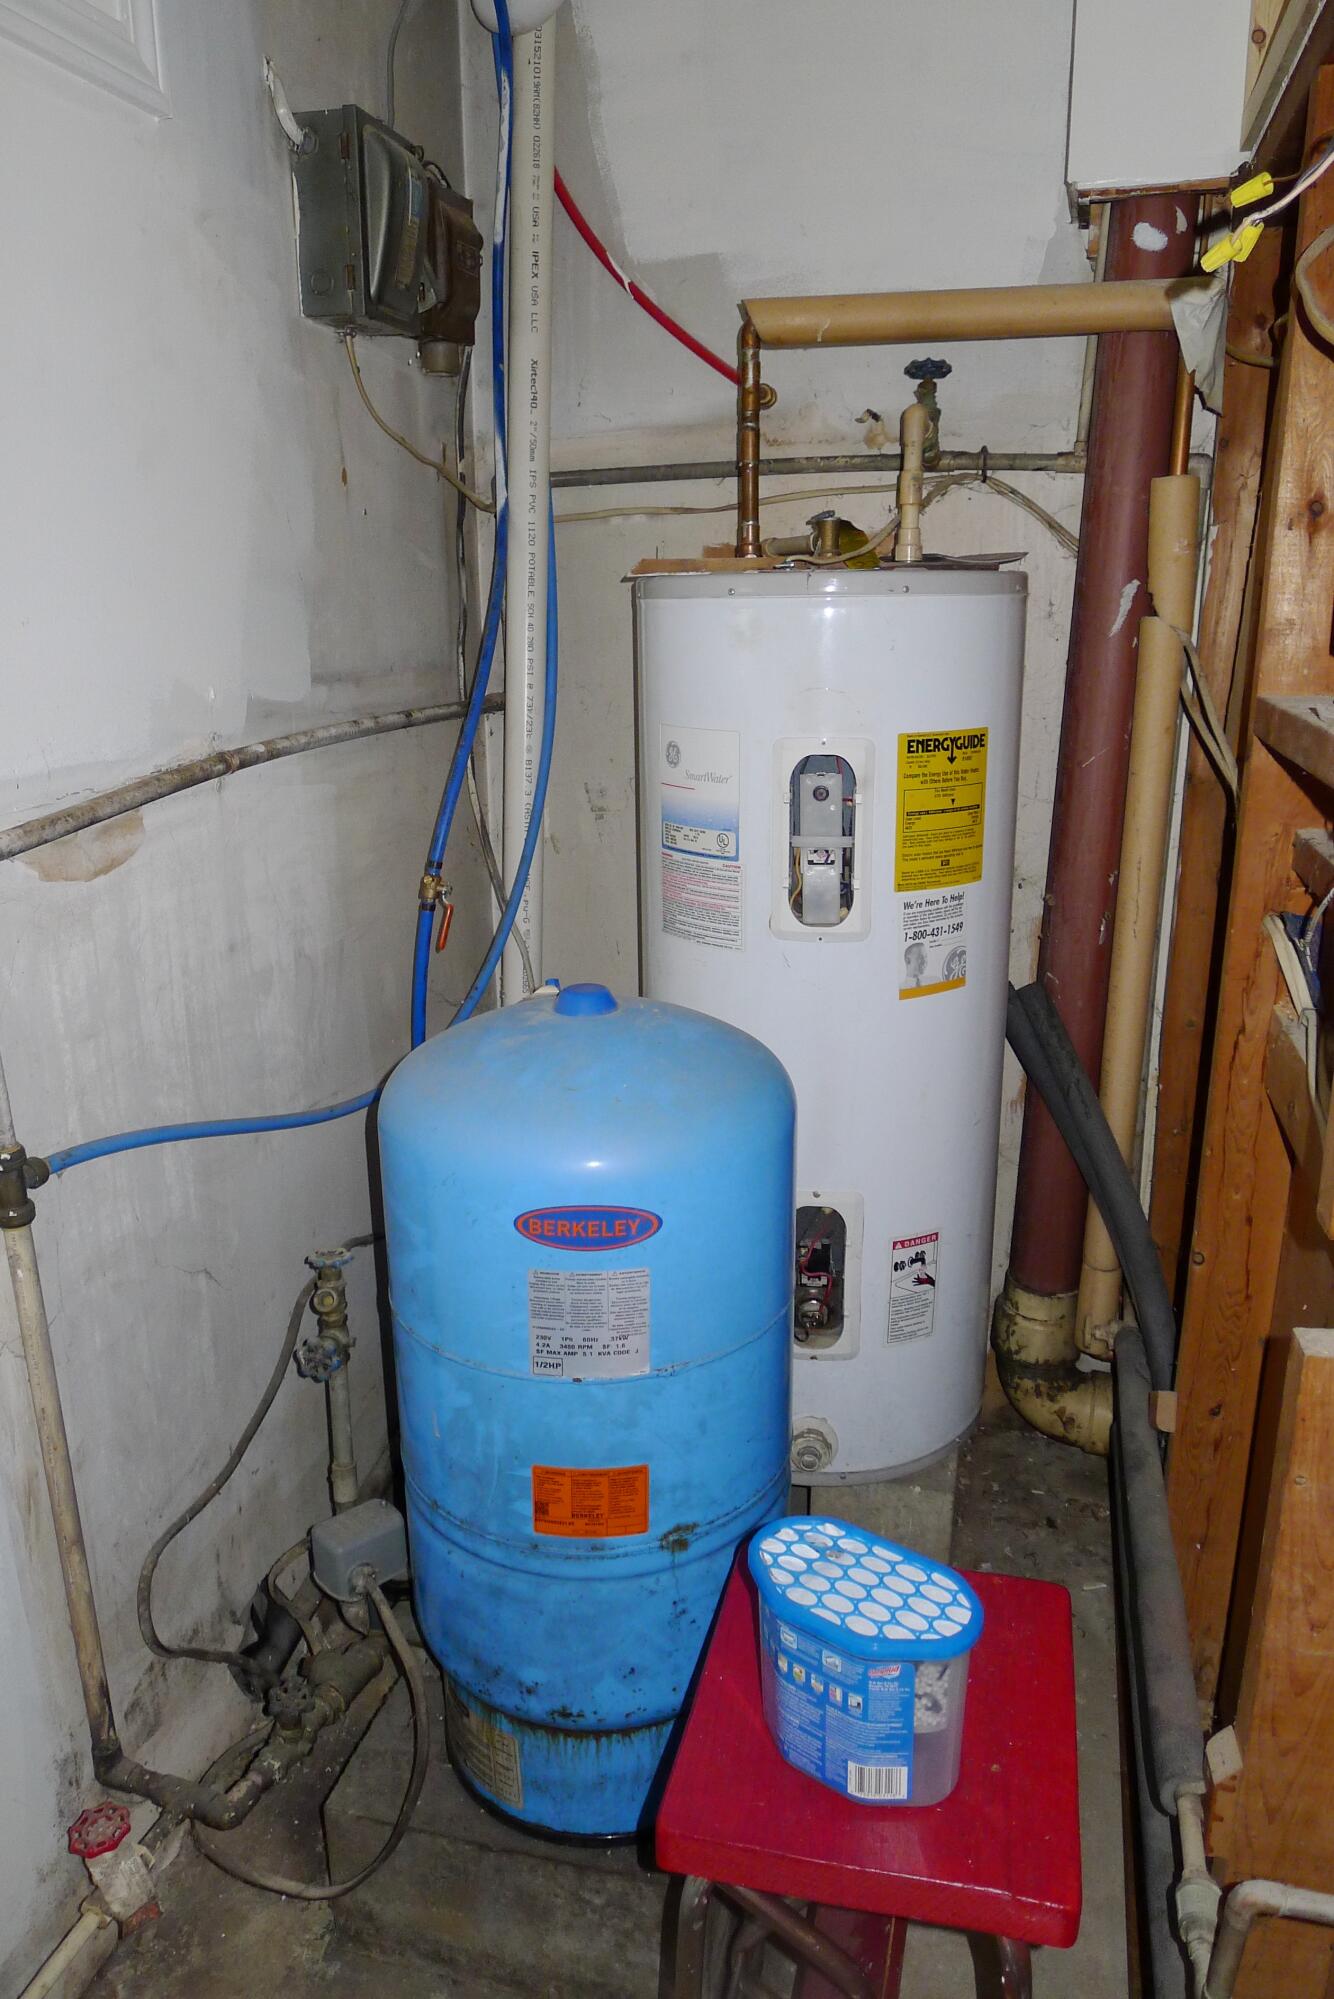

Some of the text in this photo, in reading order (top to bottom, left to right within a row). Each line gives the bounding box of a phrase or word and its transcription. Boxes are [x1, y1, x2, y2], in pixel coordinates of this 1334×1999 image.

[532, 206, 540, 227] USA
[532, 250, 540, 279] IPEX
[530, 312, 540, 333] LLC
[529, 469, 537, 488] IPS
[528, 494, 537, 514] PVC
[528, 521, 536, 546] 1120
[527, 552, 536, 598] POTABLE
[526, 657, 535, 675] PSI
[906, 733, 986, 755] ENERGYGUIDE
[685, 769, 730, 784] SmartWater
[903, 900, 923, 910] We're
[925, 898, 940, 907] Here
[949, 892, 965, 903] Help!
[904, 921, 964, 942] 1-800-431-1549
[529, 1218, 641, 1238] BERKELEY
[904, 1234, 937, 1247] DANGER
[535, 1361, 561, 1369] 1/2HP
